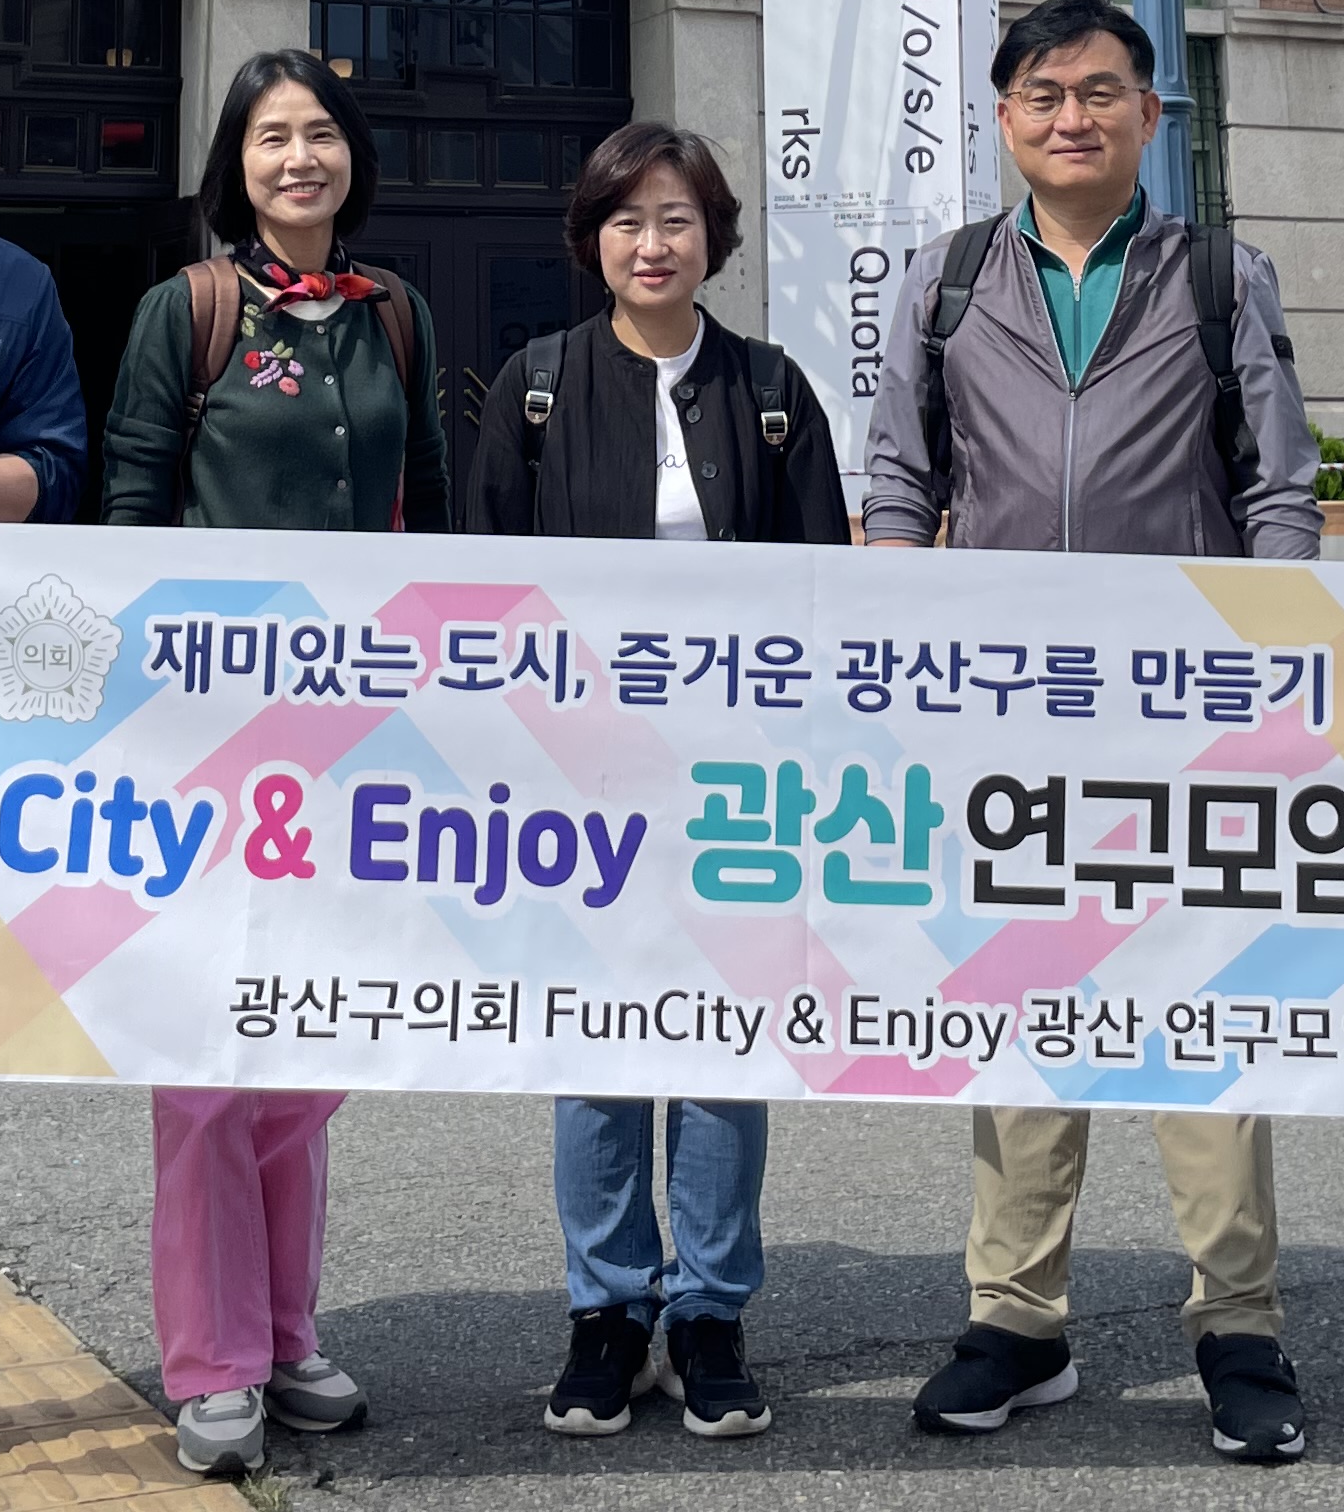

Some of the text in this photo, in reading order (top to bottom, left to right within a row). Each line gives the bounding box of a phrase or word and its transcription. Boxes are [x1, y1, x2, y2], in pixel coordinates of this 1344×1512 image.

[780, 107, 821, 181] rks
[22, 642, 73, 672] 의회
[150, 620, 418, 698] 재미있는
[437, 628, 586, 703] 도시,
[609, 631, 812, 708] 즐거운
[835, 638, 1105, 719] 광산구를
[1130, 647, 1325, 726] 만들기
[243, 774, 317, 880] &
[350, 782, 648, 909] Enjoy
[685, 759, 945, 906] 광산
[229, 974, 521, 1044] 광산구의회
[544, 985, 766, 1057] FunCity
[786, 992, 826, 1045] &
[849, 994, 1008, 1064] Enjoy
[1026, 995, 1144, 1060] 광산
